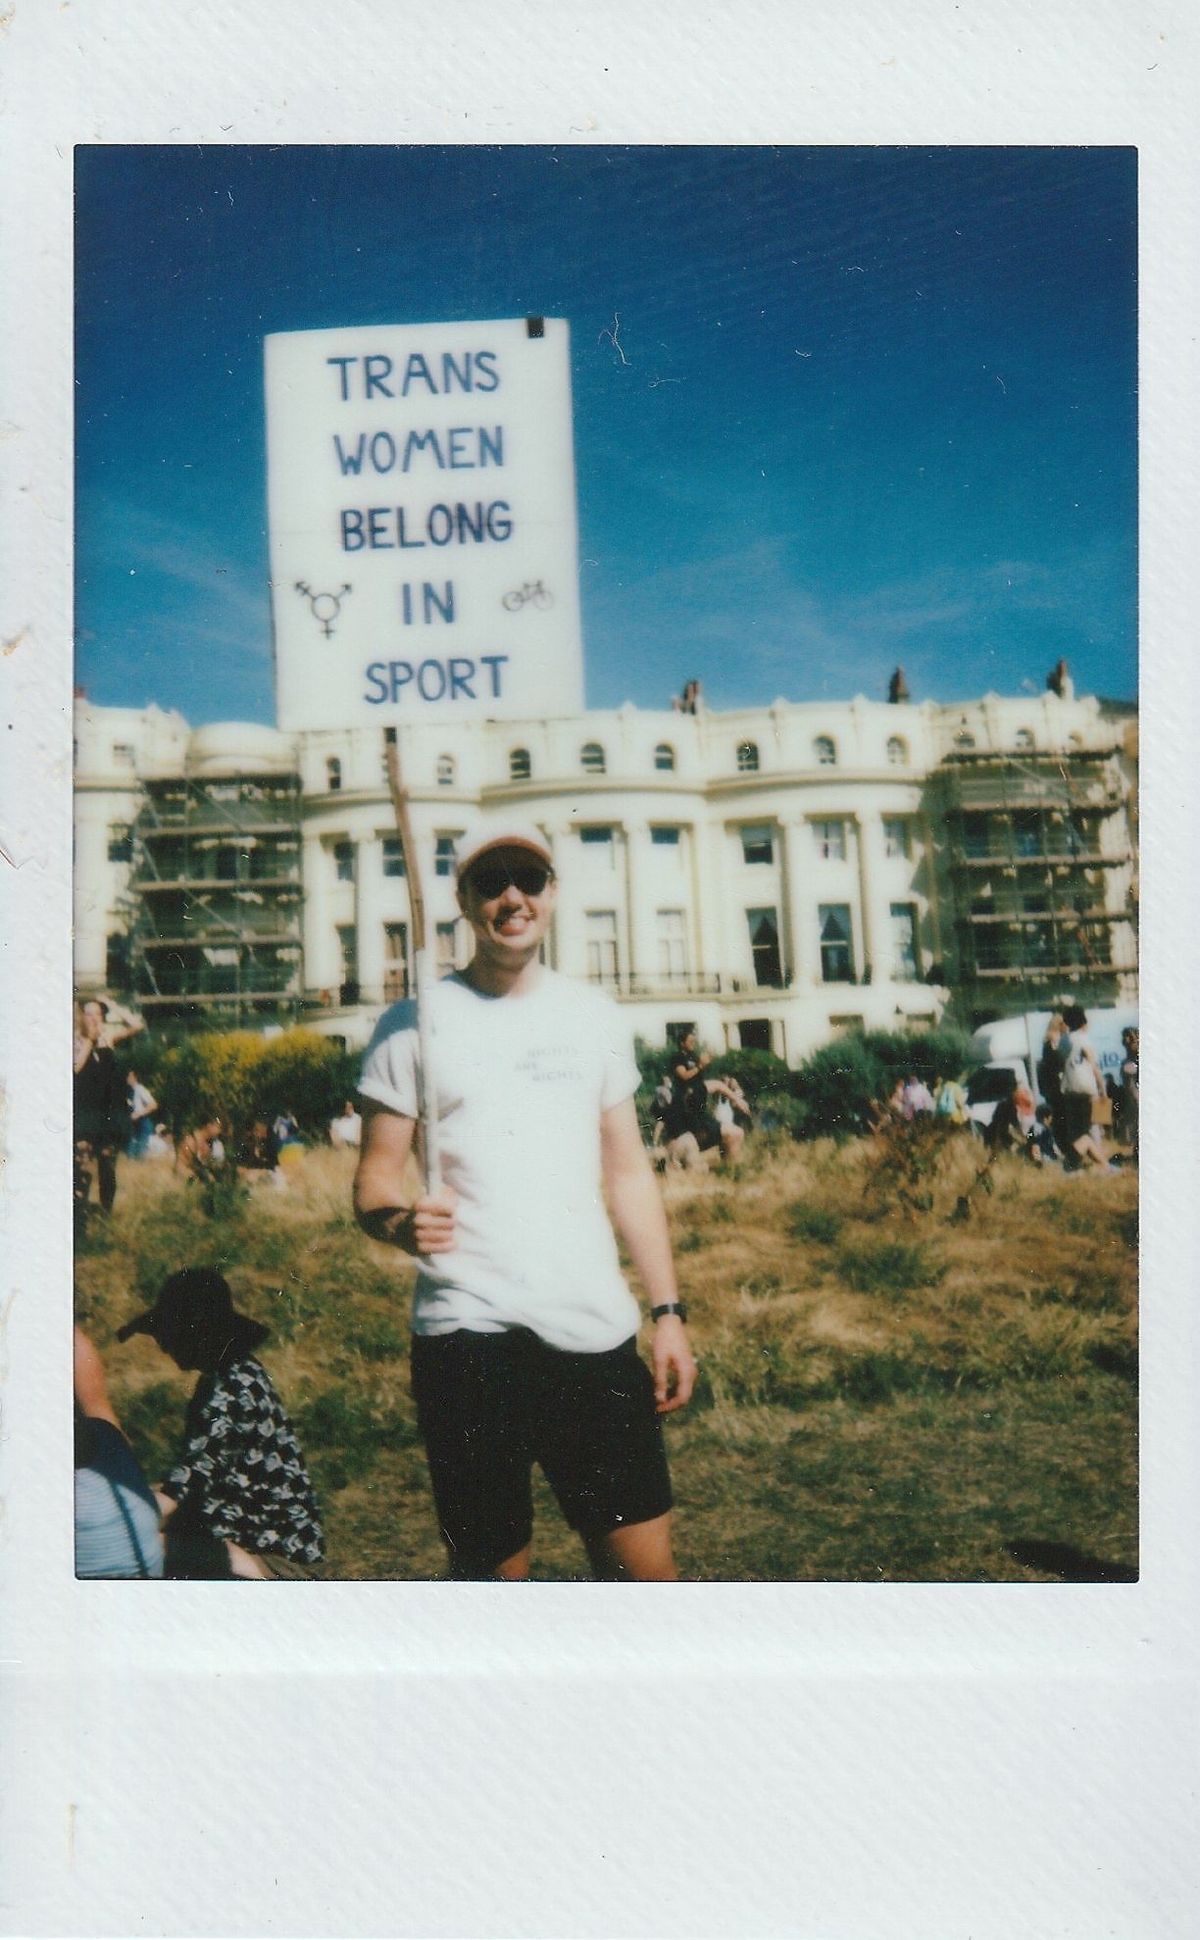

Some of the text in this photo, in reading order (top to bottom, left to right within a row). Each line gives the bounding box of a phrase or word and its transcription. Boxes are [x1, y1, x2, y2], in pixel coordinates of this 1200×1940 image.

[326, 350, 501, 402] TRANS
[333, 425, 504, 476] WOMEN
[340, 500, 514, 552] BELONG
[402, 580, 456, 626] IN
[364, 655, 509, 705] SPORT
